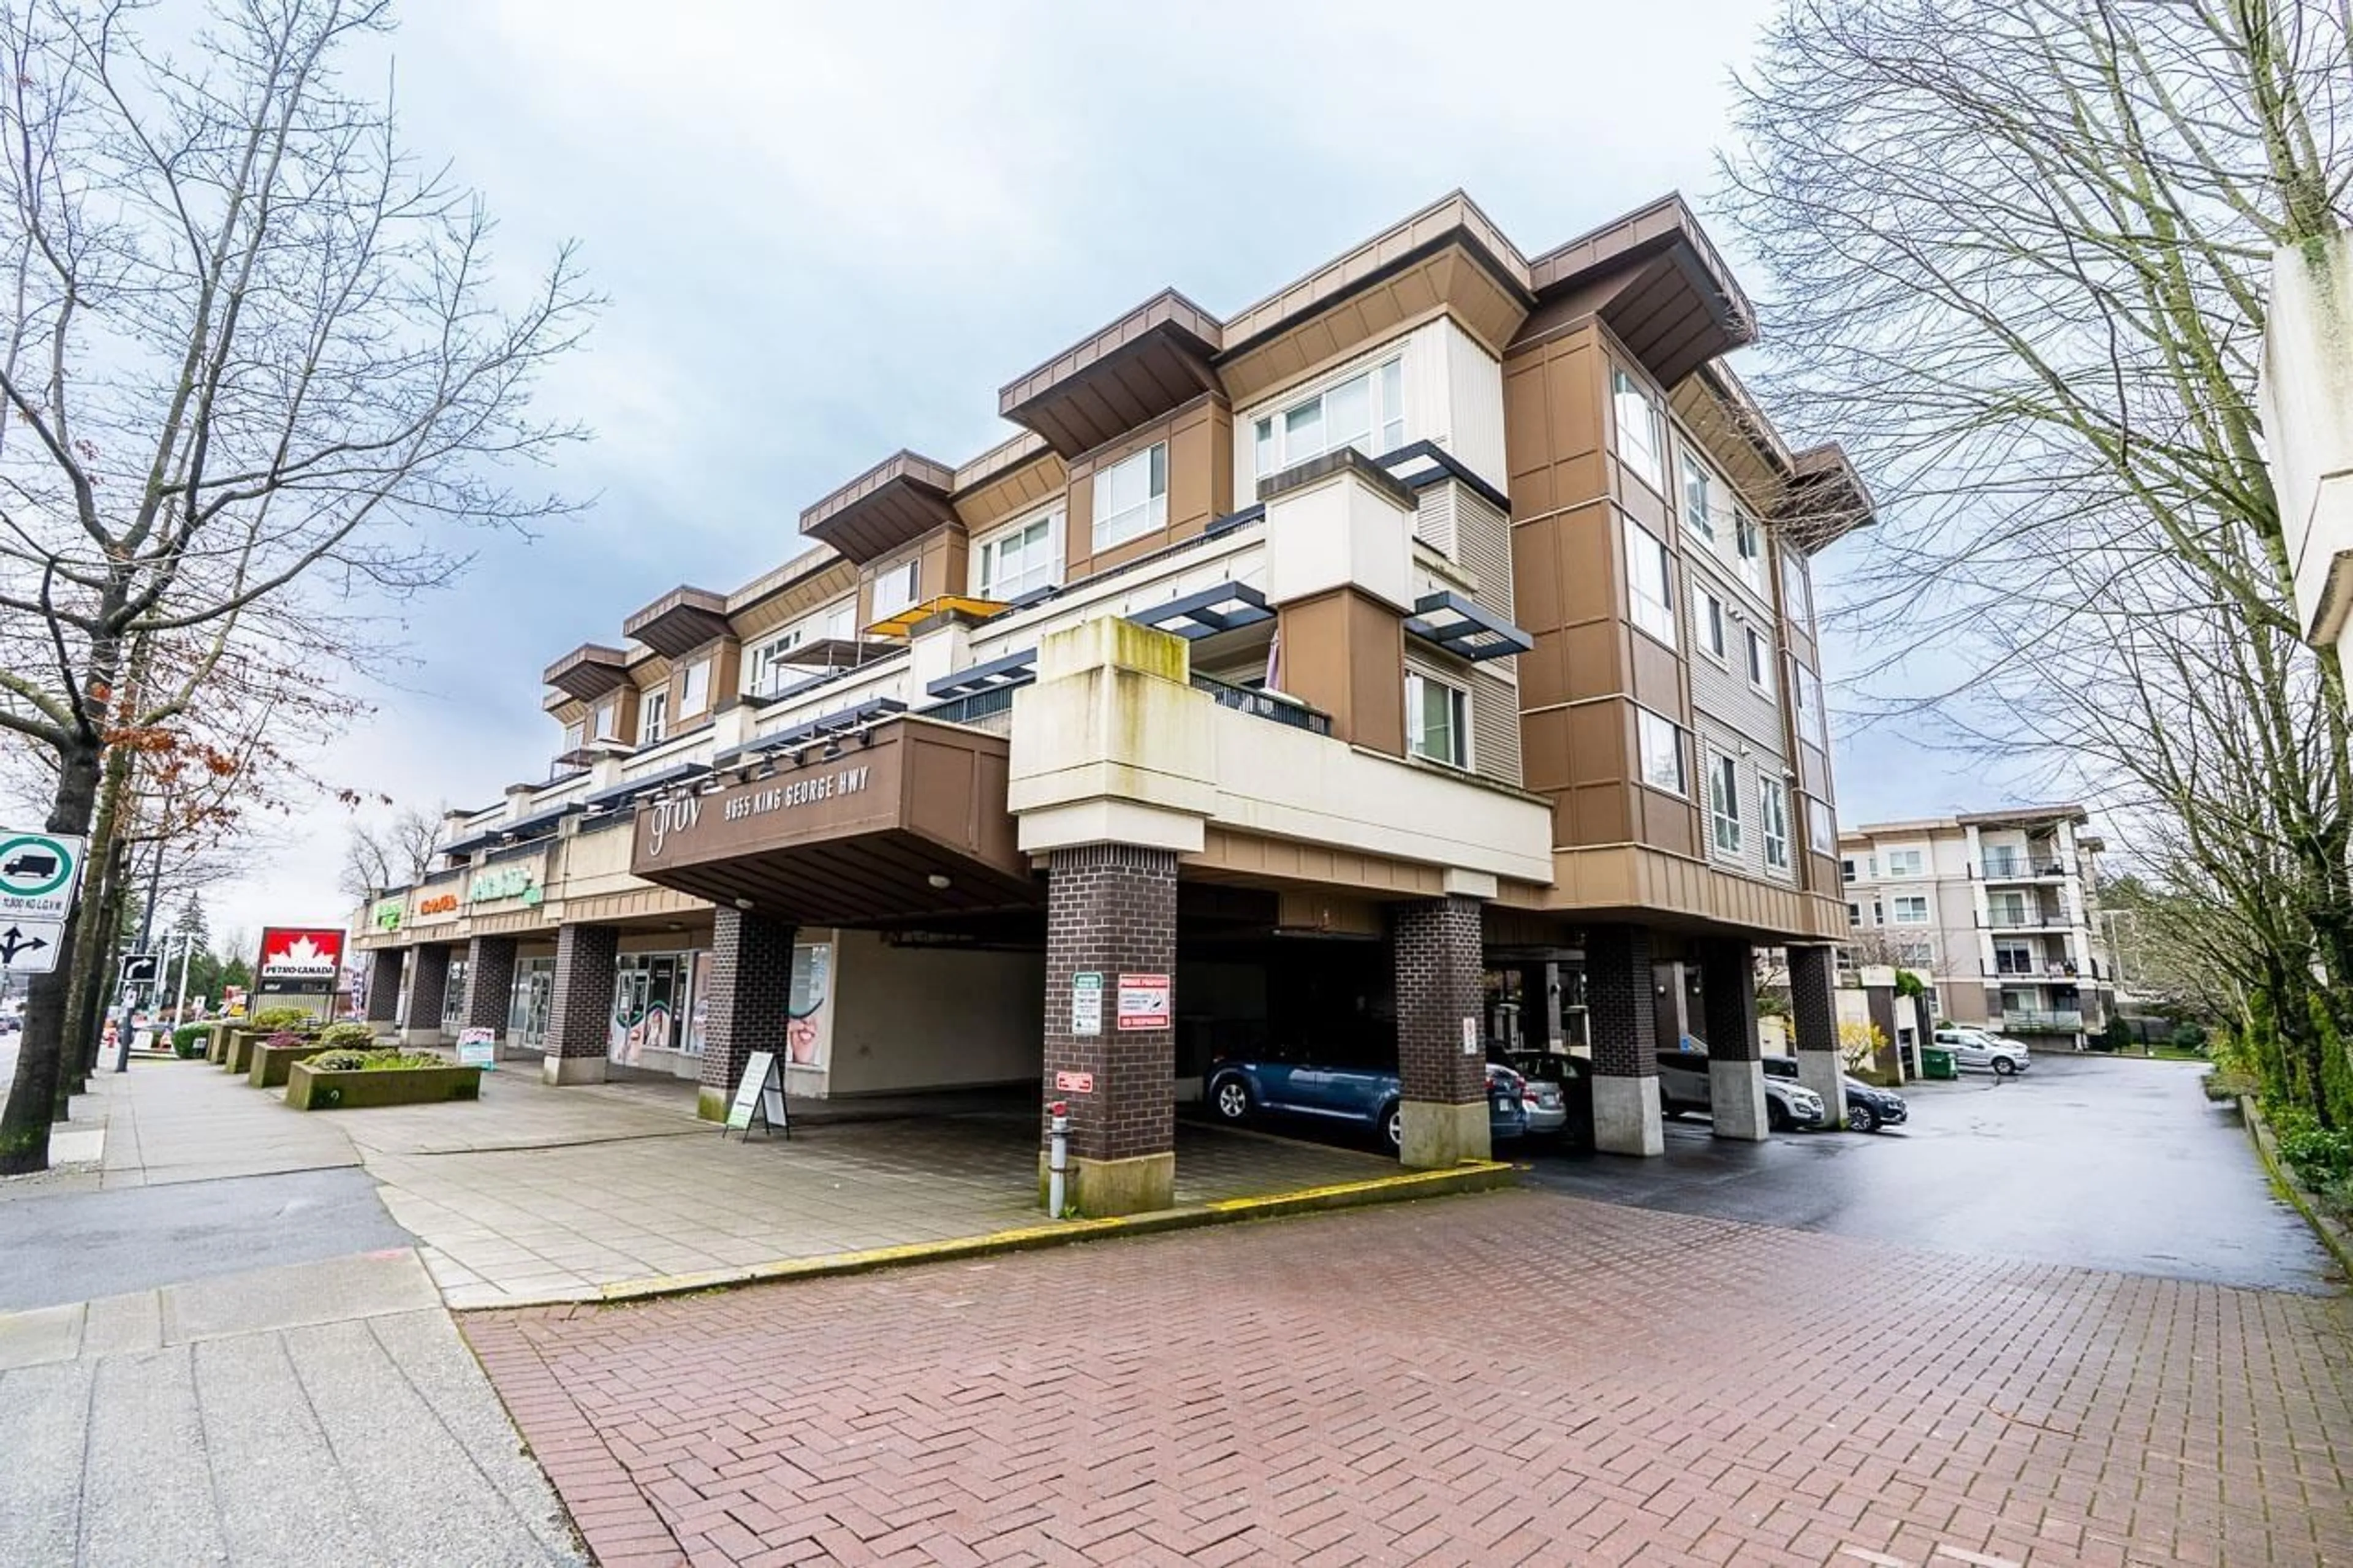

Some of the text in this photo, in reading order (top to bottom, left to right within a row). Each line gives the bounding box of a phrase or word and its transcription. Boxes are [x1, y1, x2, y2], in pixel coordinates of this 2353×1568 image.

[725, 766, 869, 821] 9655 KING GEORGE HWY
